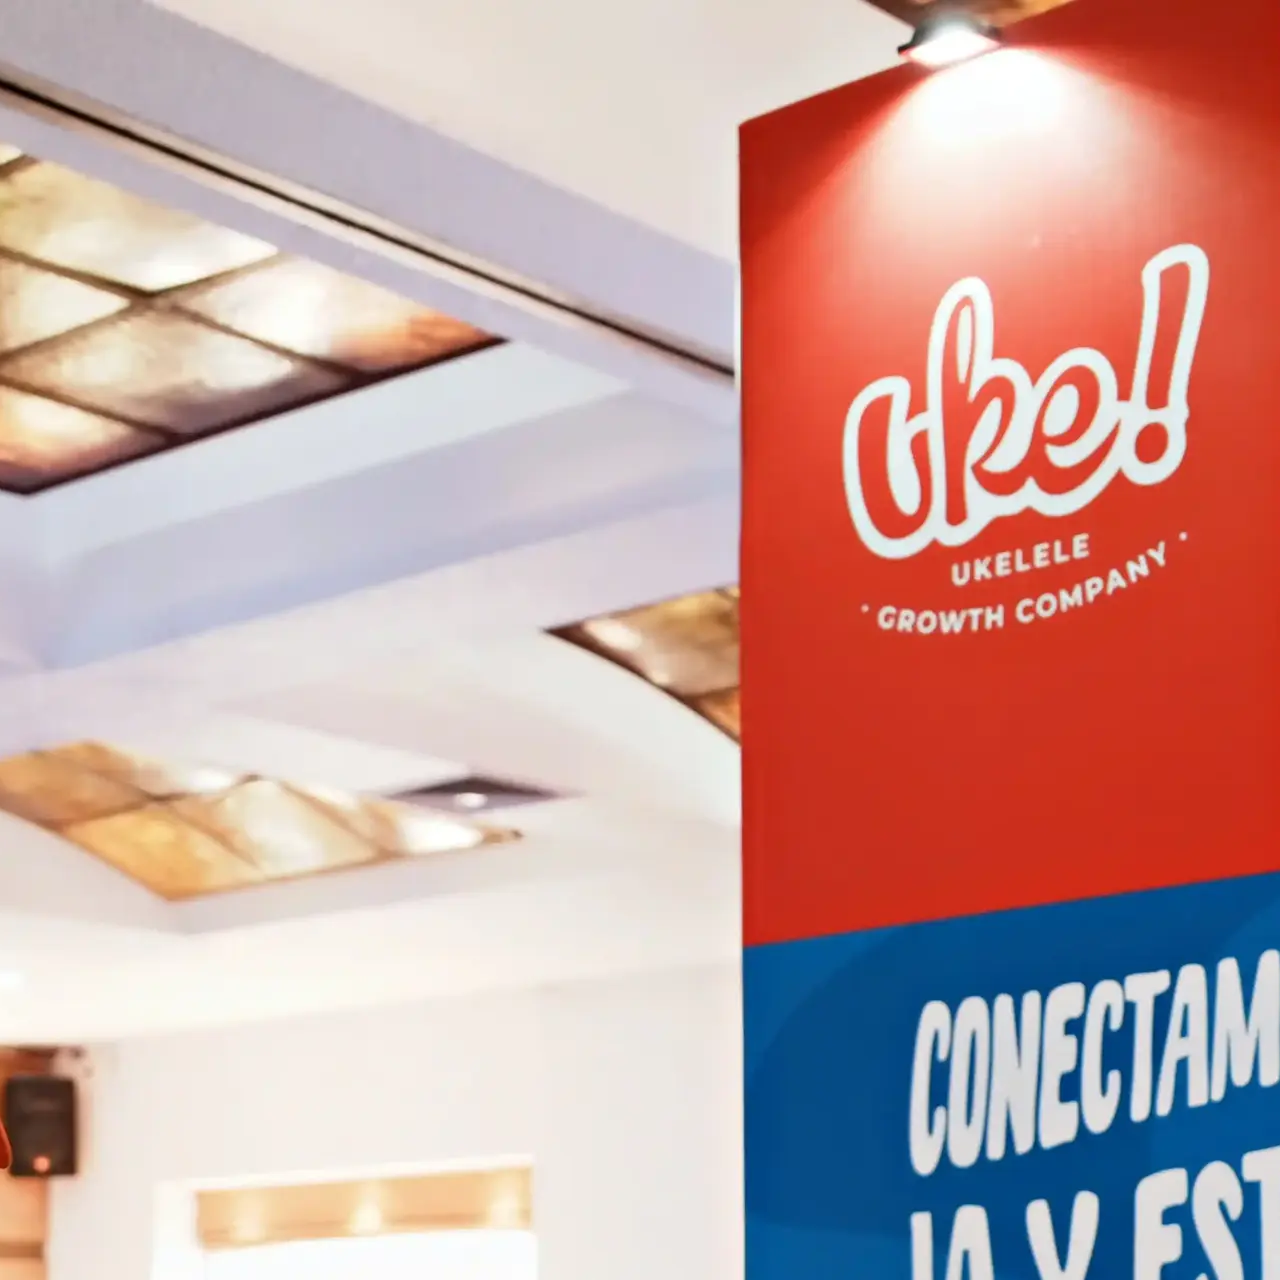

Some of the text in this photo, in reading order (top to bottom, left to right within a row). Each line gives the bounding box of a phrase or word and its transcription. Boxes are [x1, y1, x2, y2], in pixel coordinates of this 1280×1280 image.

[877, 540, 1167, 635] GROWTH COMPANY
[951, 533, 1090, 587] UKELELE
